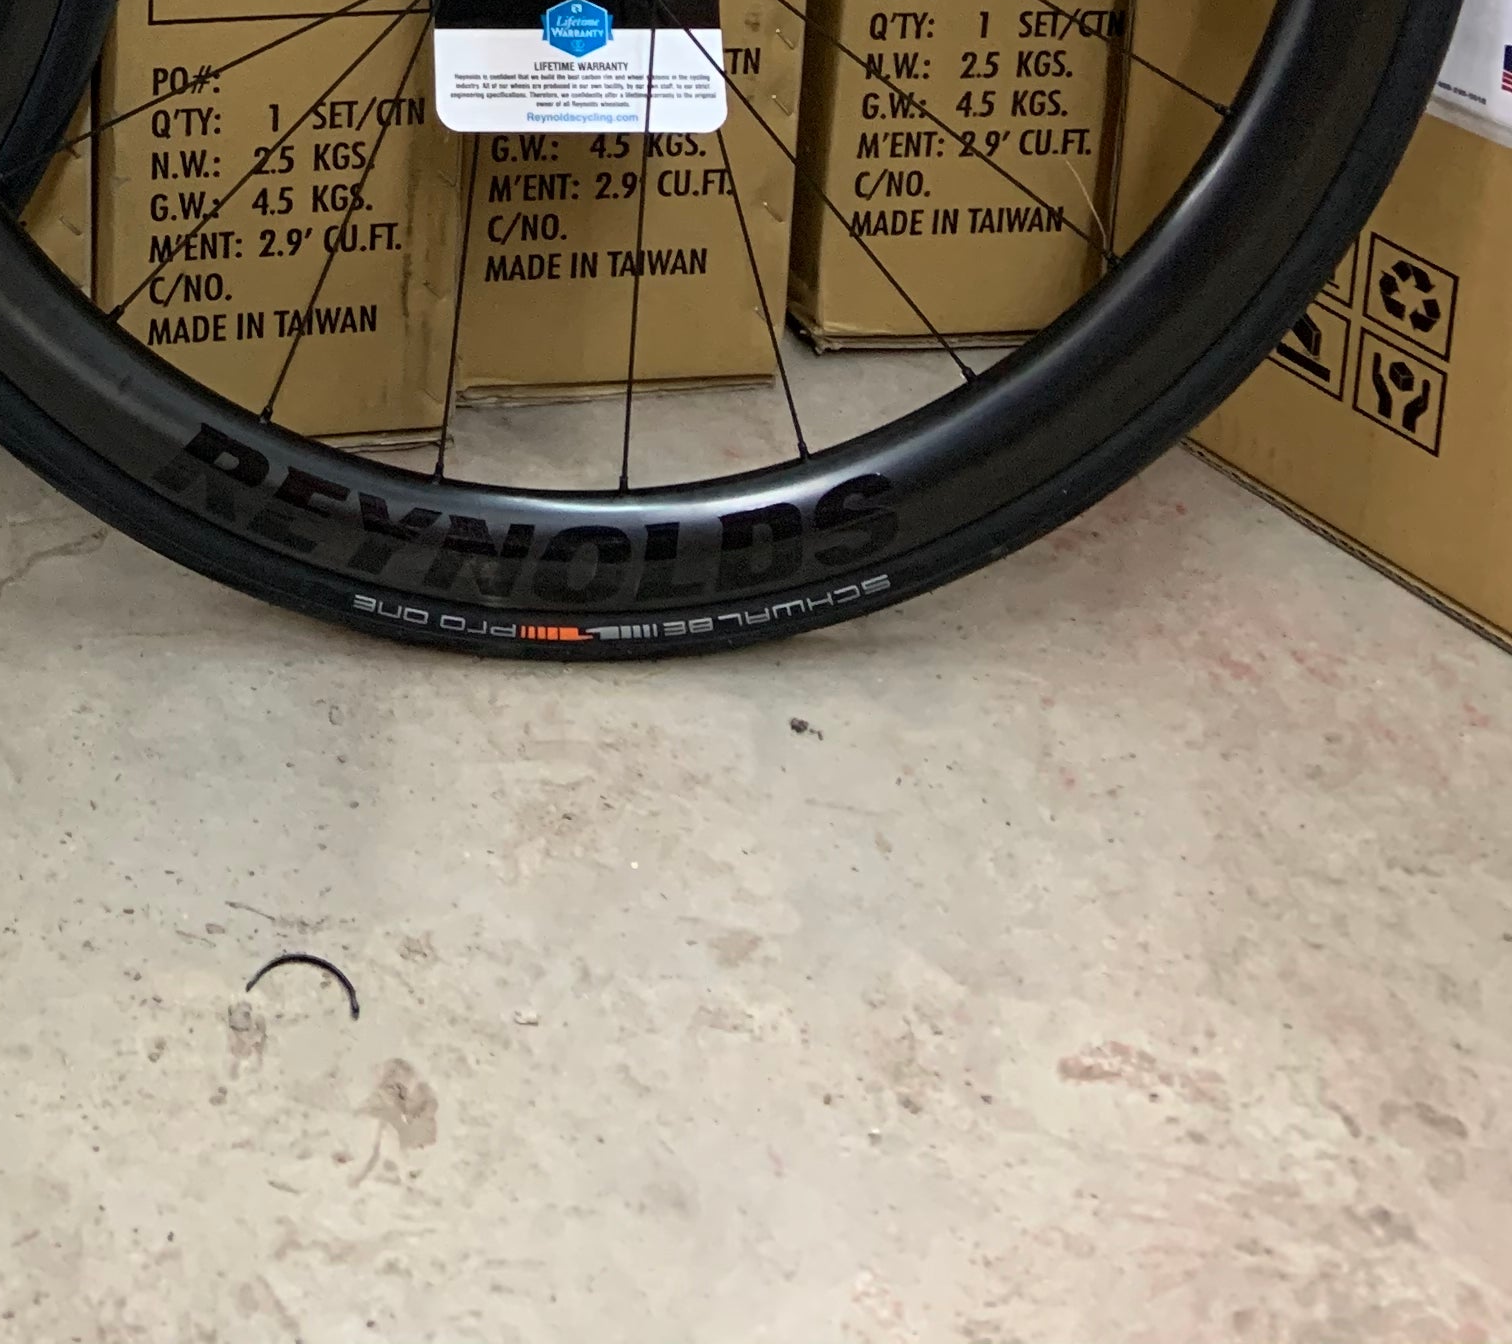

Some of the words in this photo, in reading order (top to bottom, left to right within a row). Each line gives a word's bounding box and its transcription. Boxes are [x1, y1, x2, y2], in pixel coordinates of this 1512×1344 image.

[979, 11, 989, 39] 1
[1019, 8, 1125, 40] SET/CTN
[534, 61, 575, 71] LIFETIME
[578, 61, 629, 71] WARRANTY
[960, 51, 1001, 79] 2.5
[956, 90, 996, 118] 4.5
[849, 209, 924, 238] MADE
[931, 207, 959, 235] IN
[967, 206, 1064, 235] TAIWAN
[484, 252, 562, 283] MADE
[570, 251, 598, 280] IN
[607, 247, 707, 277] TAIWAN
[148, 313, 227, 346] MADE
[237, 311, 265, 340] IN
[274, 304, 378, 338] TAIWAN
[151, 419, 902, 605] REYNOLDS
[663, 573, 893, 636] SCHWALBE
